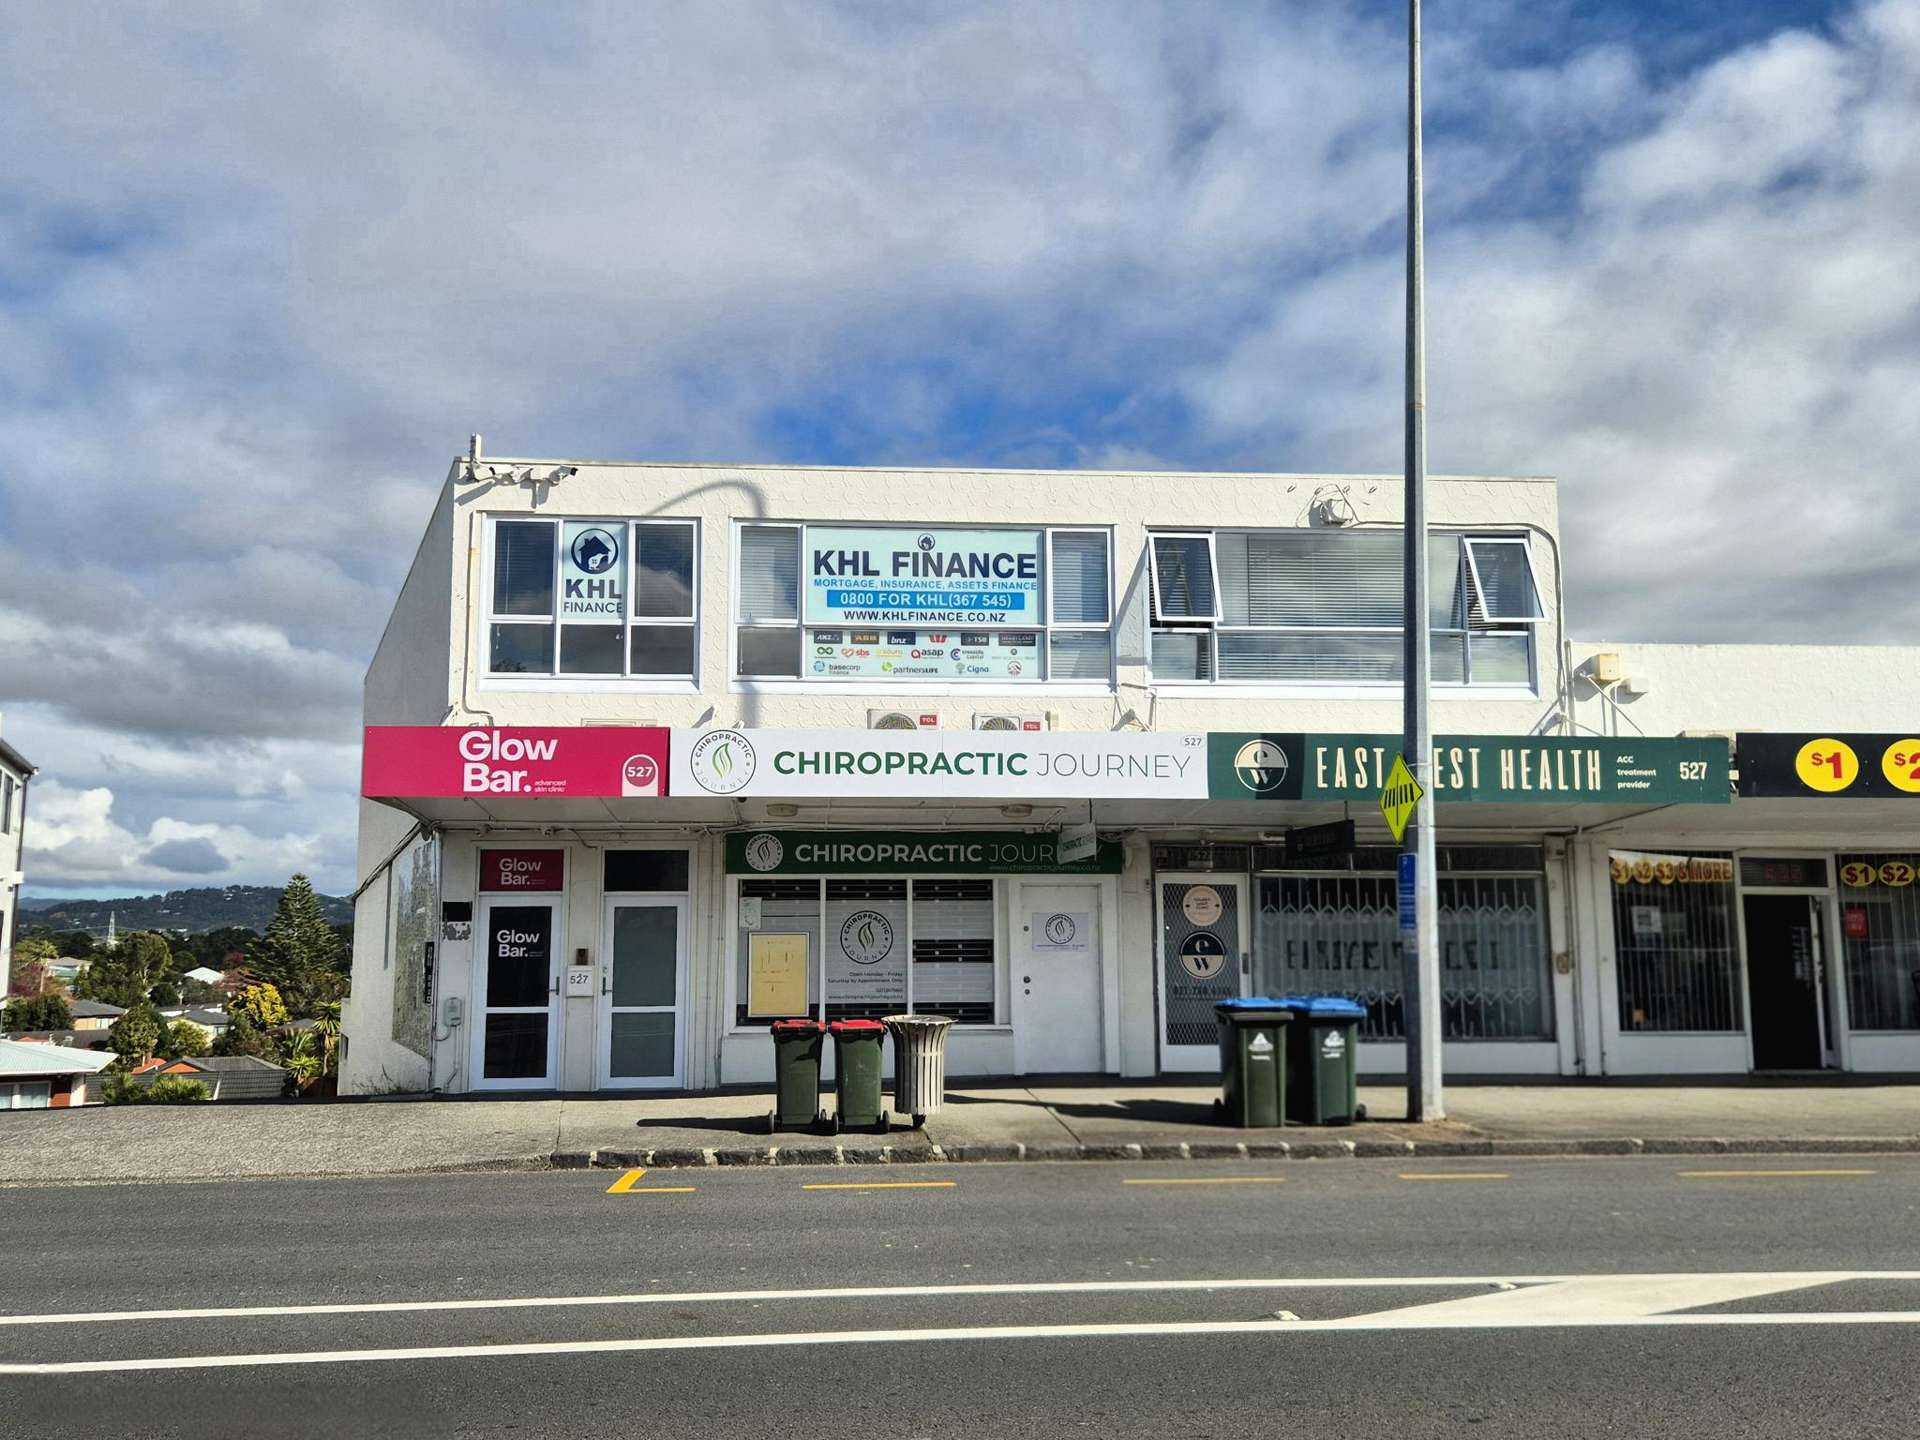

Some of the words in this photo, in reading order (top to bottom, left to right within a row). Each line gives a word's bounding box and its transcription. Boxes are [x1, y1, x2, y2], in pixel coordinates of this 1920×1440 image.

[814, 550, 880, 576] KHL
[892, 551, 1037, 579] FINANCE
[565, 579, 622, 599] KHL
[814, 578, 878, 589] MORTGAGE,
[880, 580, 945, 590] INSURANCE,
[949, 581, 989, 590] ASSETS
[991, 582, 1037, 591] FINANCE
[563, 602, 623, 614] FINANCE
[840, 593, 874, 605] 0800
[879, 593, 912, 606] FOR
[982, 594, 1012, 609] 545)
[844, 611, 1006, 622] WWW.KHLFINANCE.CO.NZ
[890, 636, 908, 644] bnz
[921, 648, 944, 657] asap
[967, 664, 990, 674] Cigna
[459, 730, 558, 761] Glow
[695, 733, 752, 759] CHIROPRACTIC
[1184, 737, 1202, 747] 527
[774, 751, 1028, 776] CHIROPRACTIC
[1036, 753, 1191, 778] JOURNEY
[1616, 756, 1634, 764] ACC
[1811, 752, 1843, 779] $1
[627, 766, 653, 777] 527
[1316, 747, 1385, 789] EAST
[1432, 747, 1480, 790] EST
[1500, 749, 1601, 790] HEALTH
[1616, 768, 1657, 777] treatment
[1679, 762, 1708, 781] 527
[463, 762, 532, 793] Bar.
[1617, 780, 1651, 790] provider
[795, 844, 983, 862] CHIROPRACTIC
[499, 857, 542, 872] Glow
[501, 872, 531, 885] Bar.
[1845, 866, 1871, 884] $1
[1882, 866, 1910, 883] $2
[844, 913, 890, 935] CHIROPRACTIC
[496, 929, 540, 943] Glow
[498, 944, 529, 957] Bar.
[570, 975, 589, 984] 527
